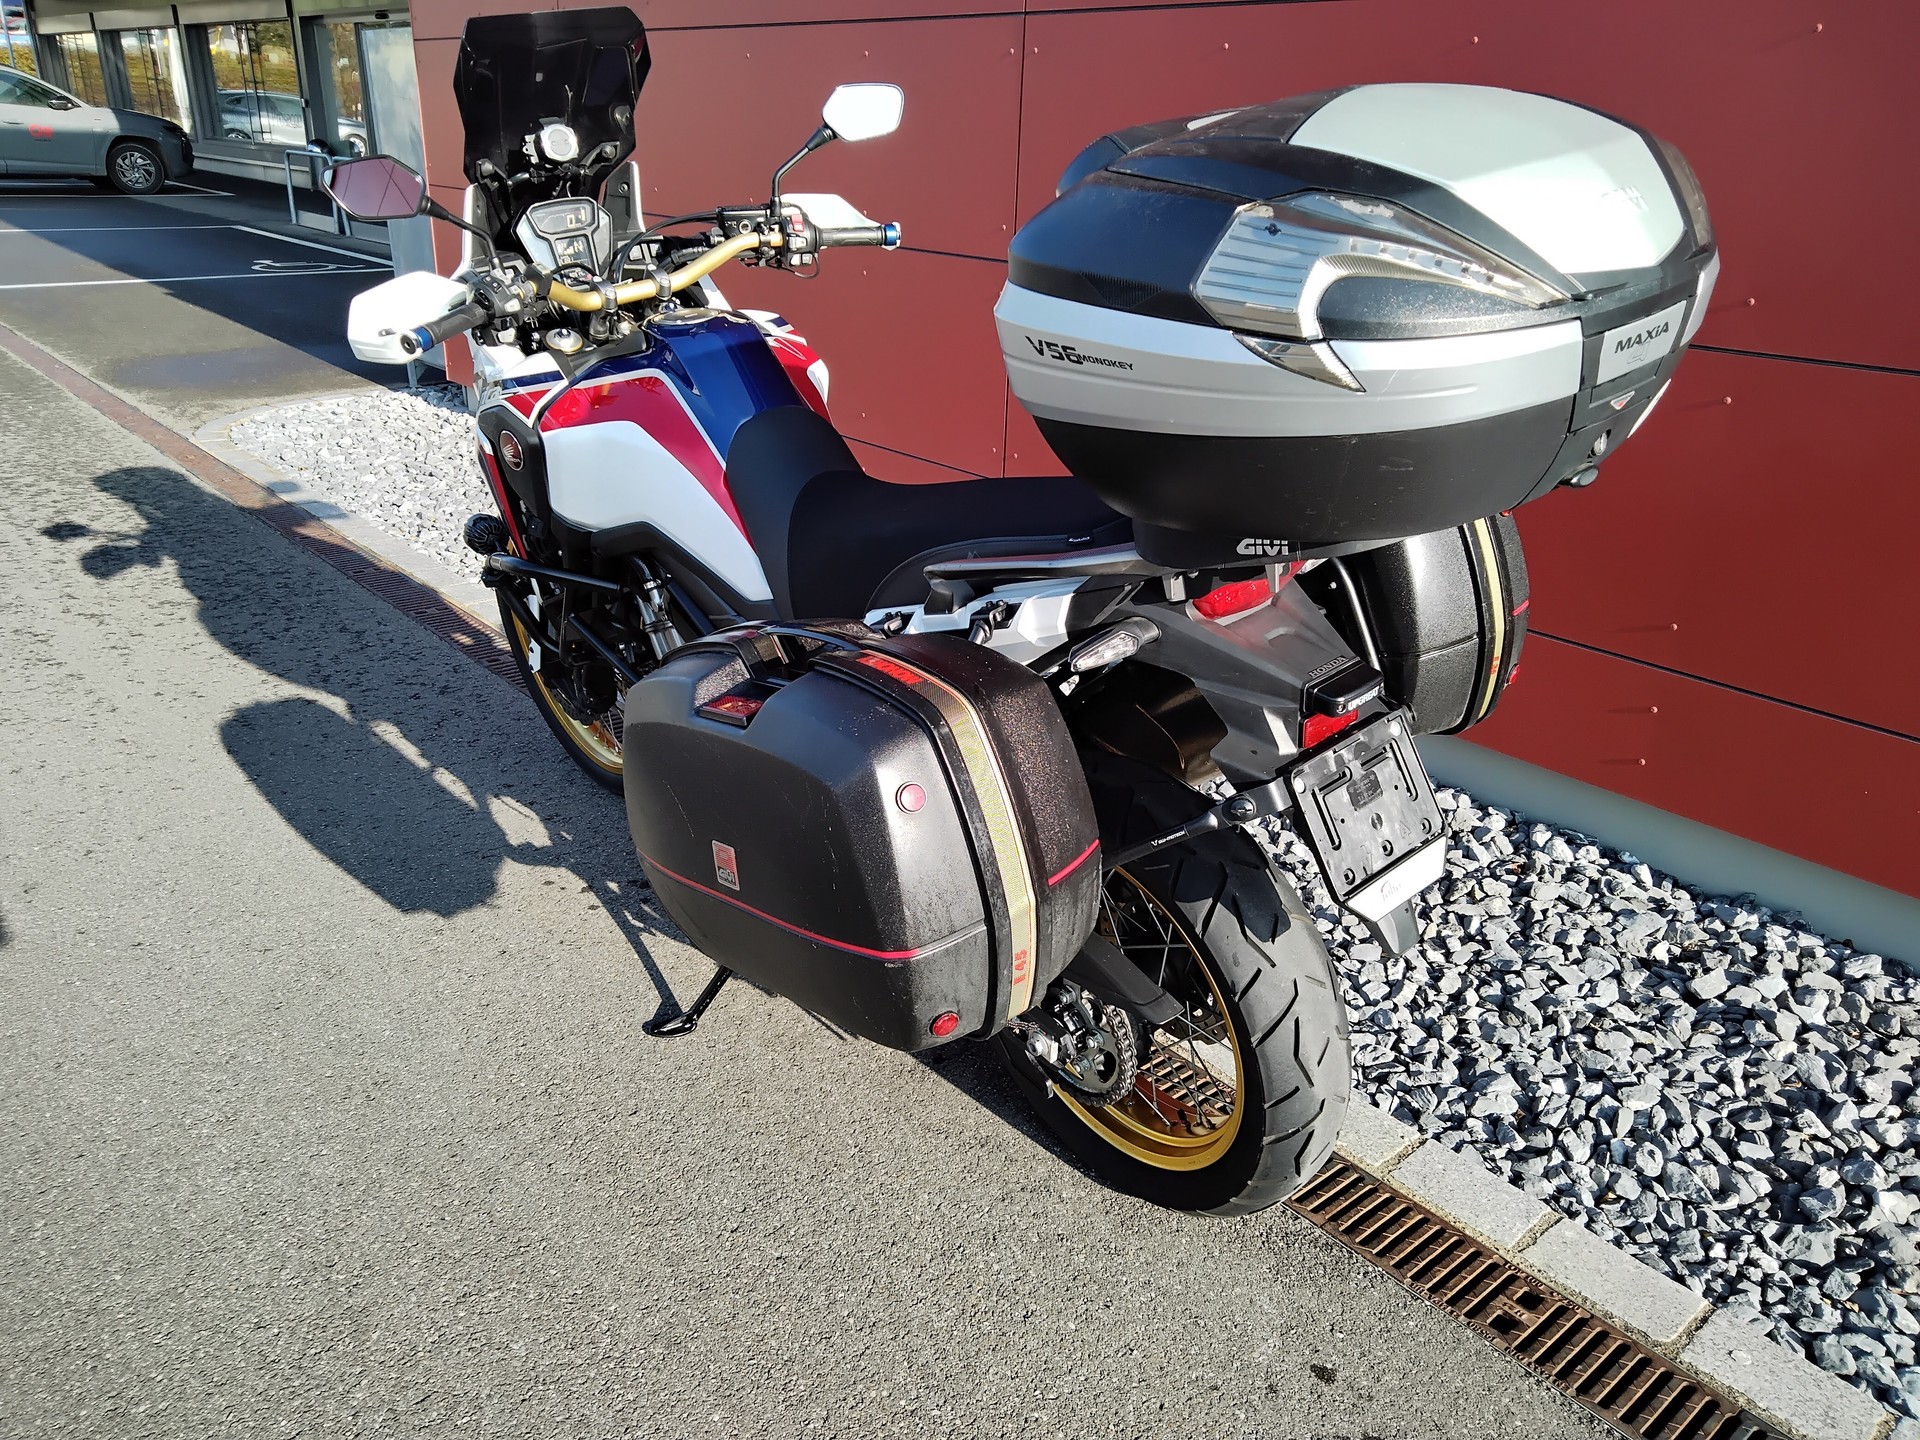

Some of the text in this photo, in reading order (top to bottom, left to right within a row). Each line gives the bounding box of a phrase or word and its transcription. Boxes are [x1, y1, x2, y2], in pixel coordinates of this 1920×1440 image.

[1024, 335, 1133, 370] V56 MONOKEY
[1236, 538, 1289, 557] GIVI
[1309, 657, 1349, 678] HONDA
